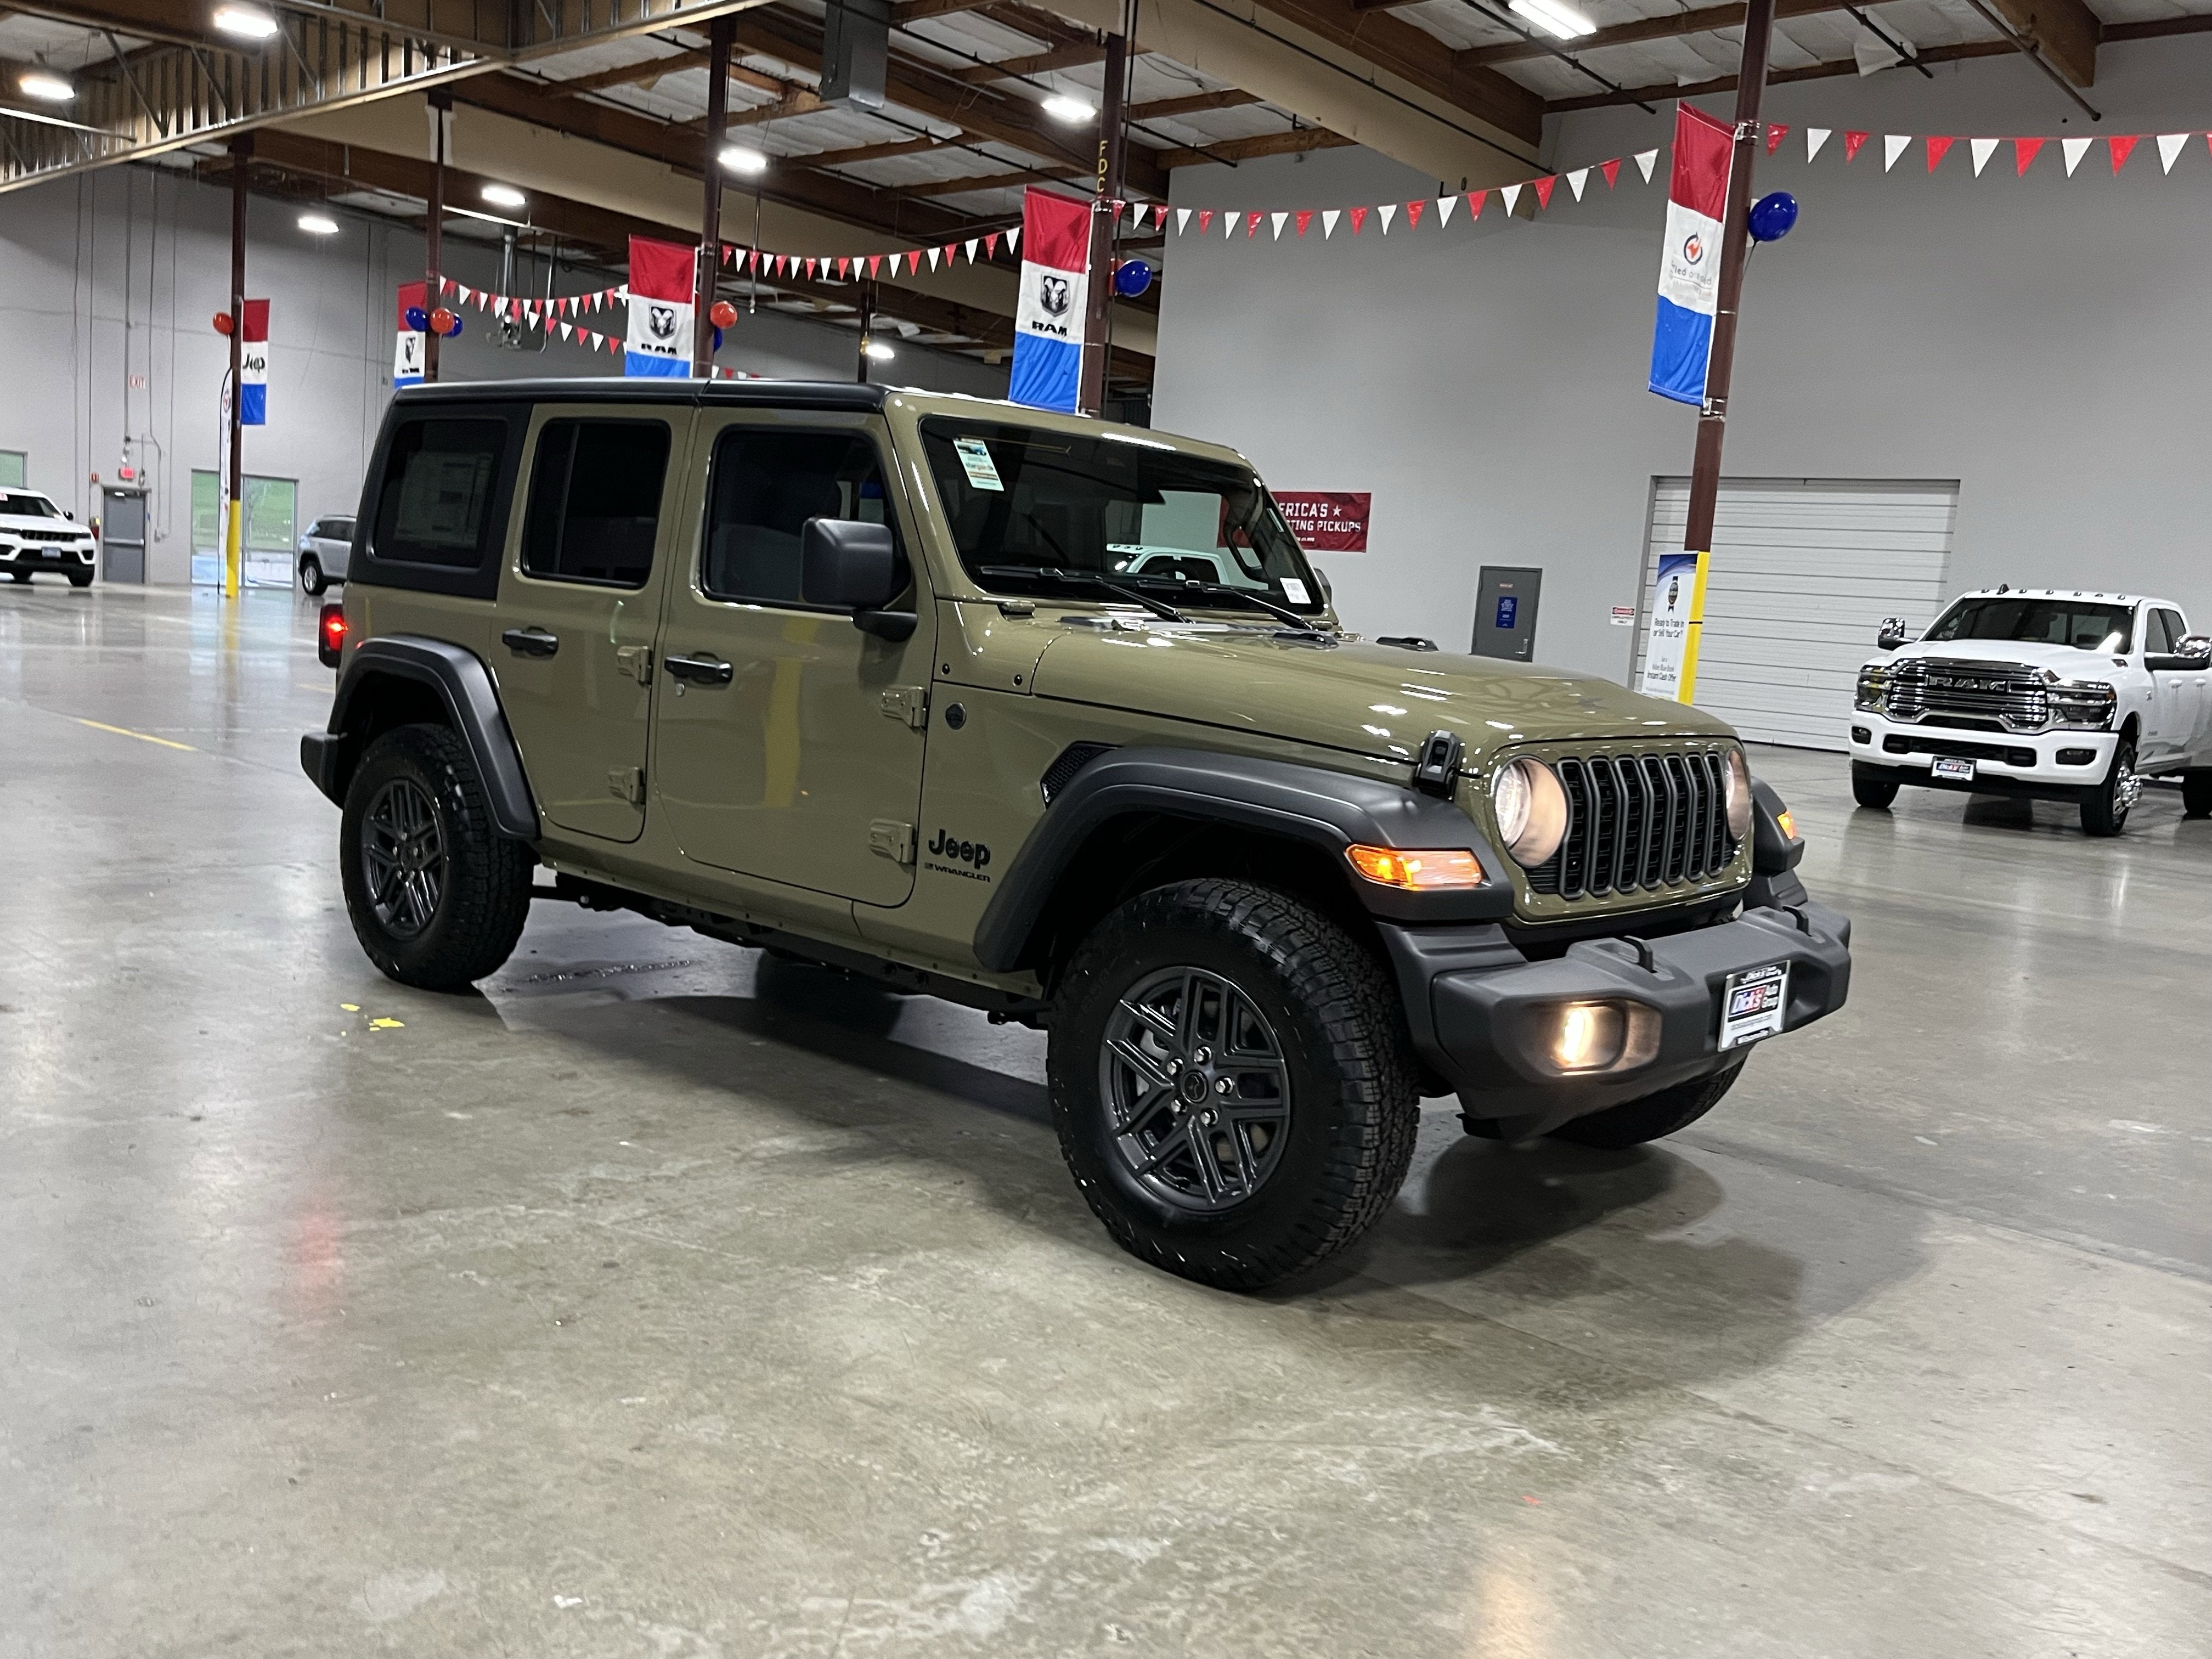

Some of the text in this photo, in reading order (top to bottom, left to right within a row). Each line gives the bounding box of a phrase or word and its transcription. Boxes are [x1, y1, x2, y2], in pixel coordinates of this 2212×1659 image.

[1032, 320, 1067, 336] RAM
[641, 343, 677, 355] RAM
[1278, 503, 1328, 517] ERICA'S
[1287, 520, 1361, 533] TING PICKUPS
[1929, 675, 2006, 691] RAM
[928, 828, 990, 870] Jeep
[934, 864, 990, 883] WRANGLER
